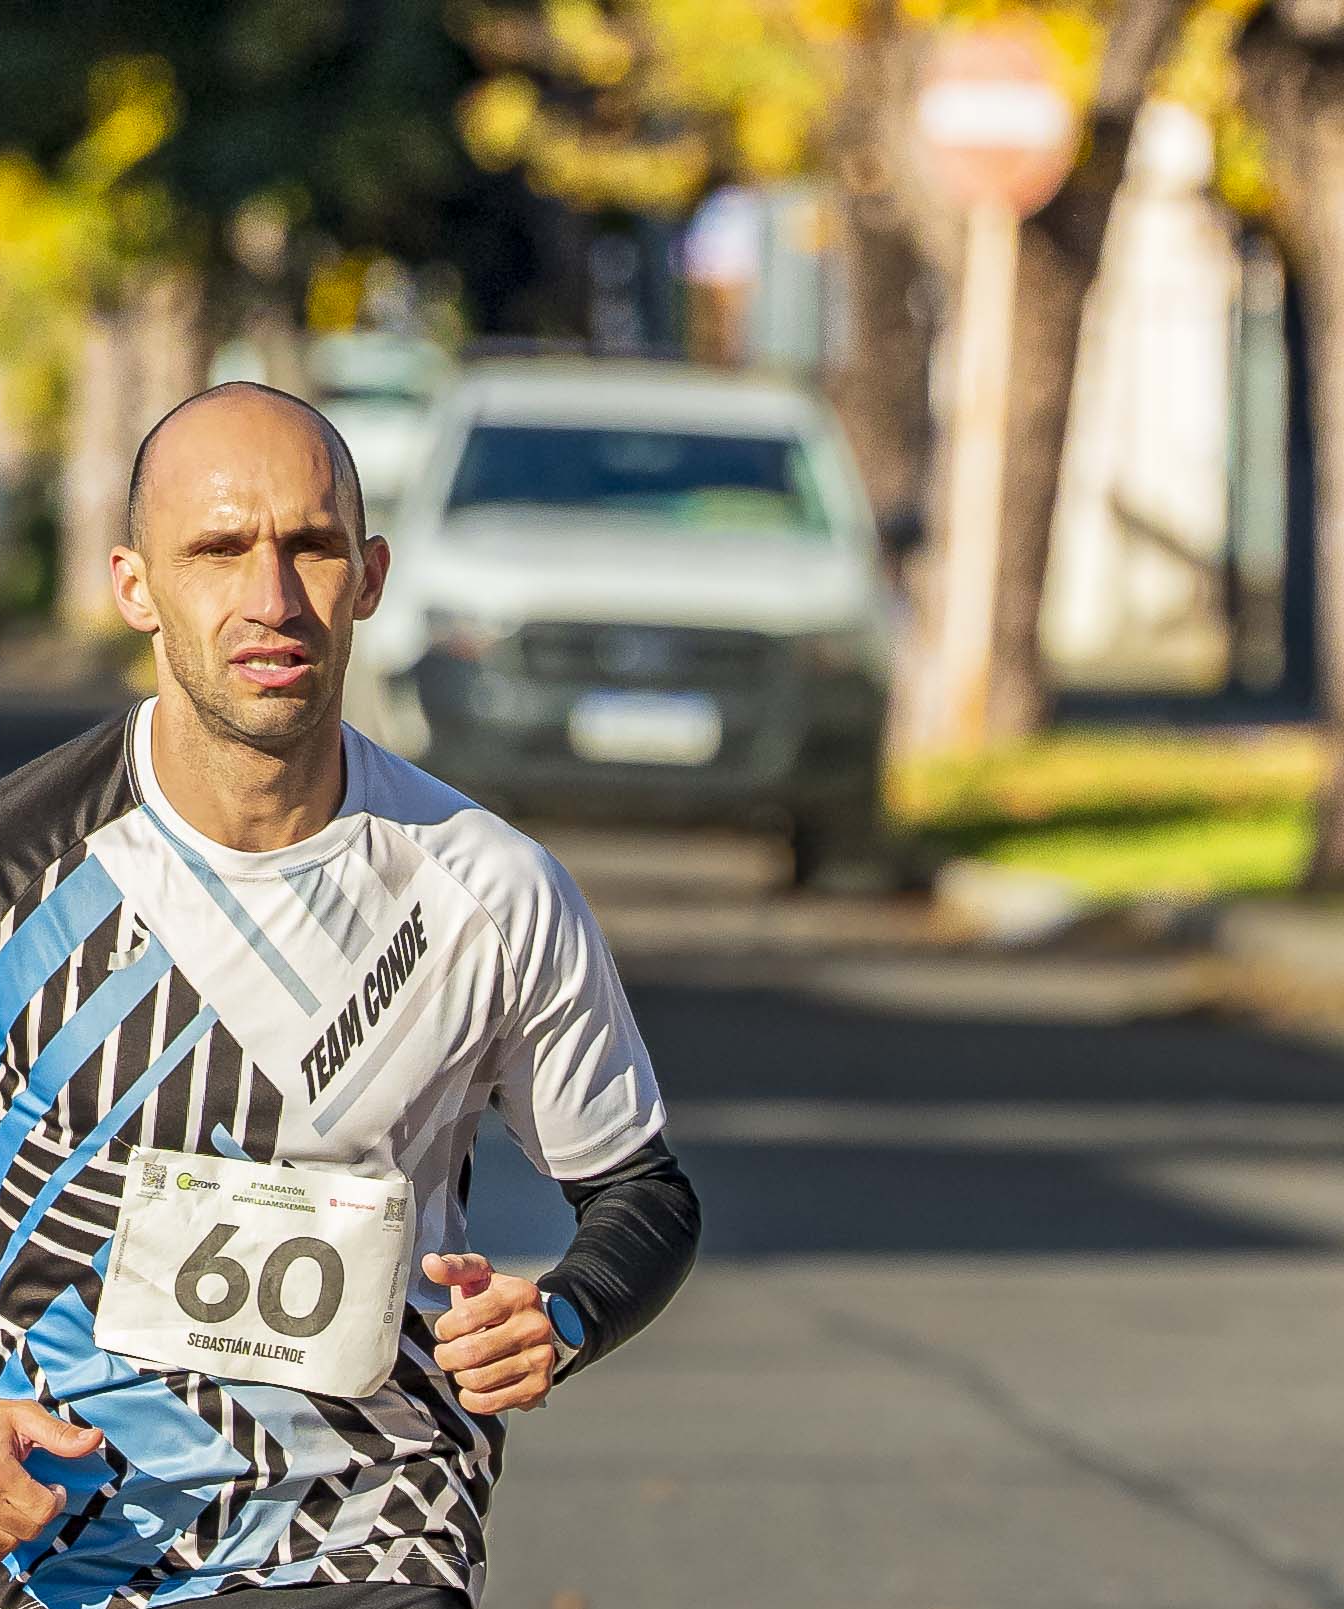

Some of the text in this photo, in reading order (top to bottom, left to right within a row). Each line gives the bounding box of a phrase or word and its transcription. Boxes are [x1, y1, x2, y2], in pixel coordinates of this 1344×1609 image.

[300, 900, 428, 1105] TEAM CONDE
[175, 1223, 345, 1338] 60
[187, 1332, 306, 1364] SEBASTIÁN ALLENDE
